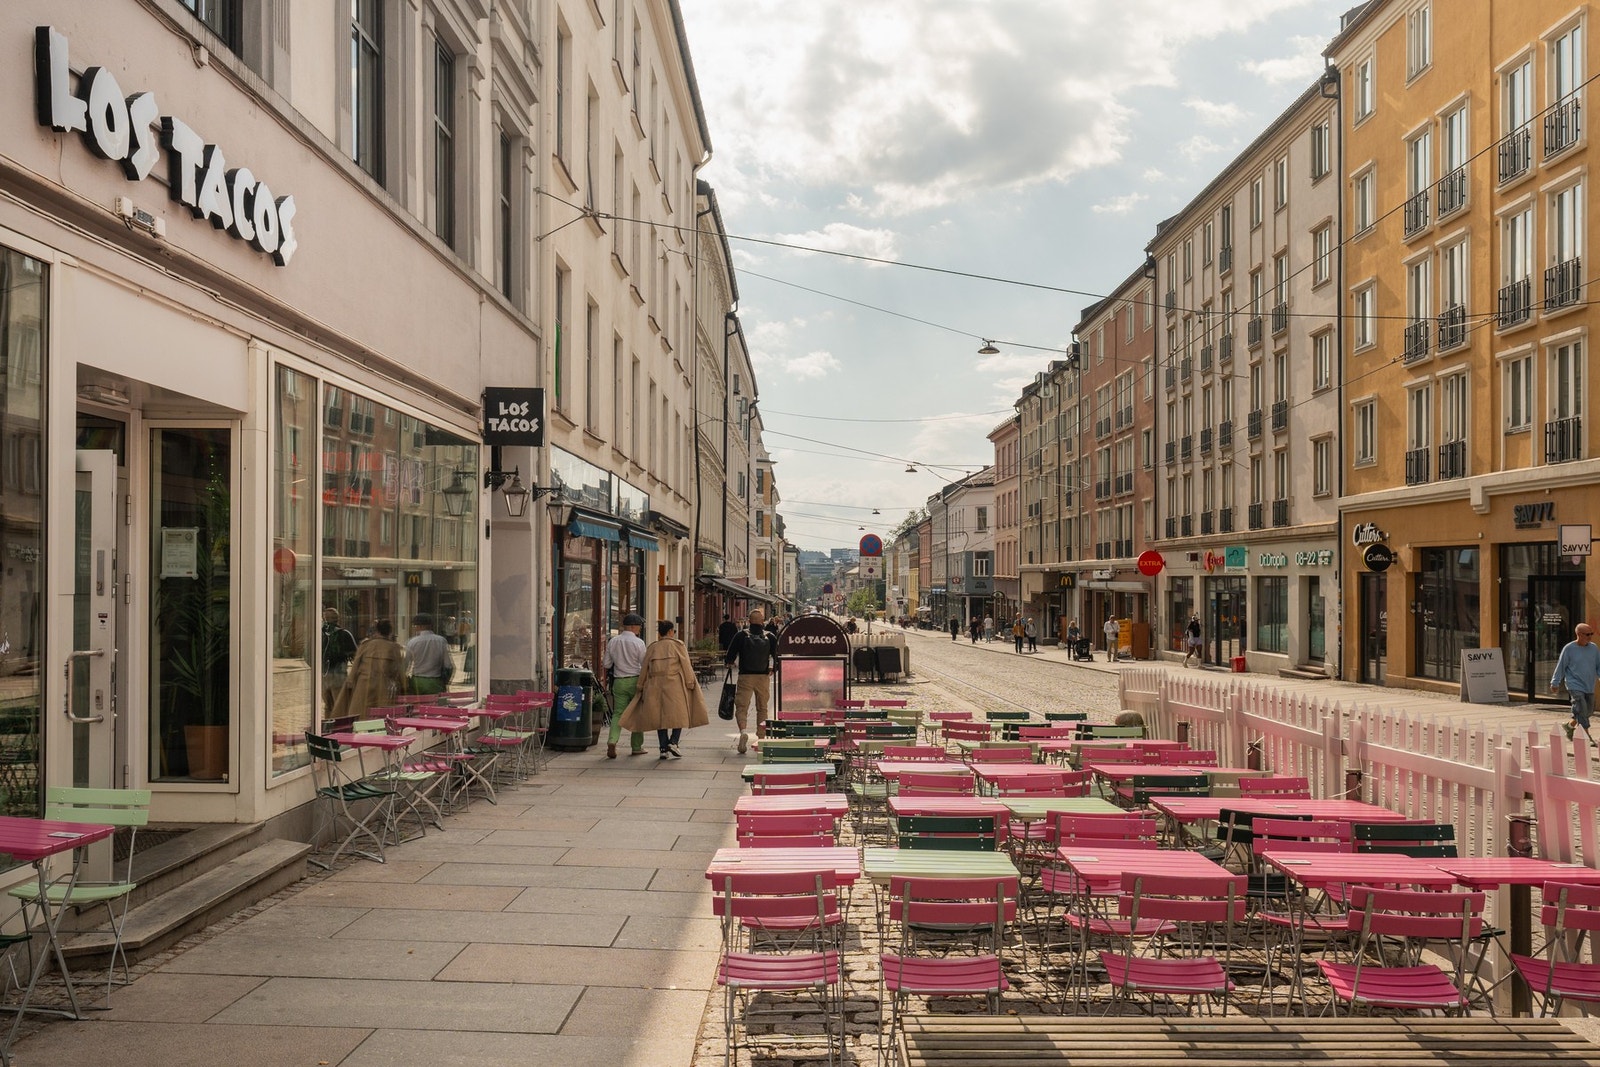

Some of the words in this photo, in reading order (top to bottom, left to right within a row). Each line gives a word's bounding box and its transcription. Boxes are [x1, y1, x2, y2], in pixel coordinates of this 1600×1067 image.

[36, 26, 160, 181] LOS
[160, 116, 297, 266] TACOS
[498, 401, 530, 417] LOS
[488, 417, 540, 433] TACOS
[788, 635, 807, 645] LOS
[807, 635, 838, 645] TACOS
